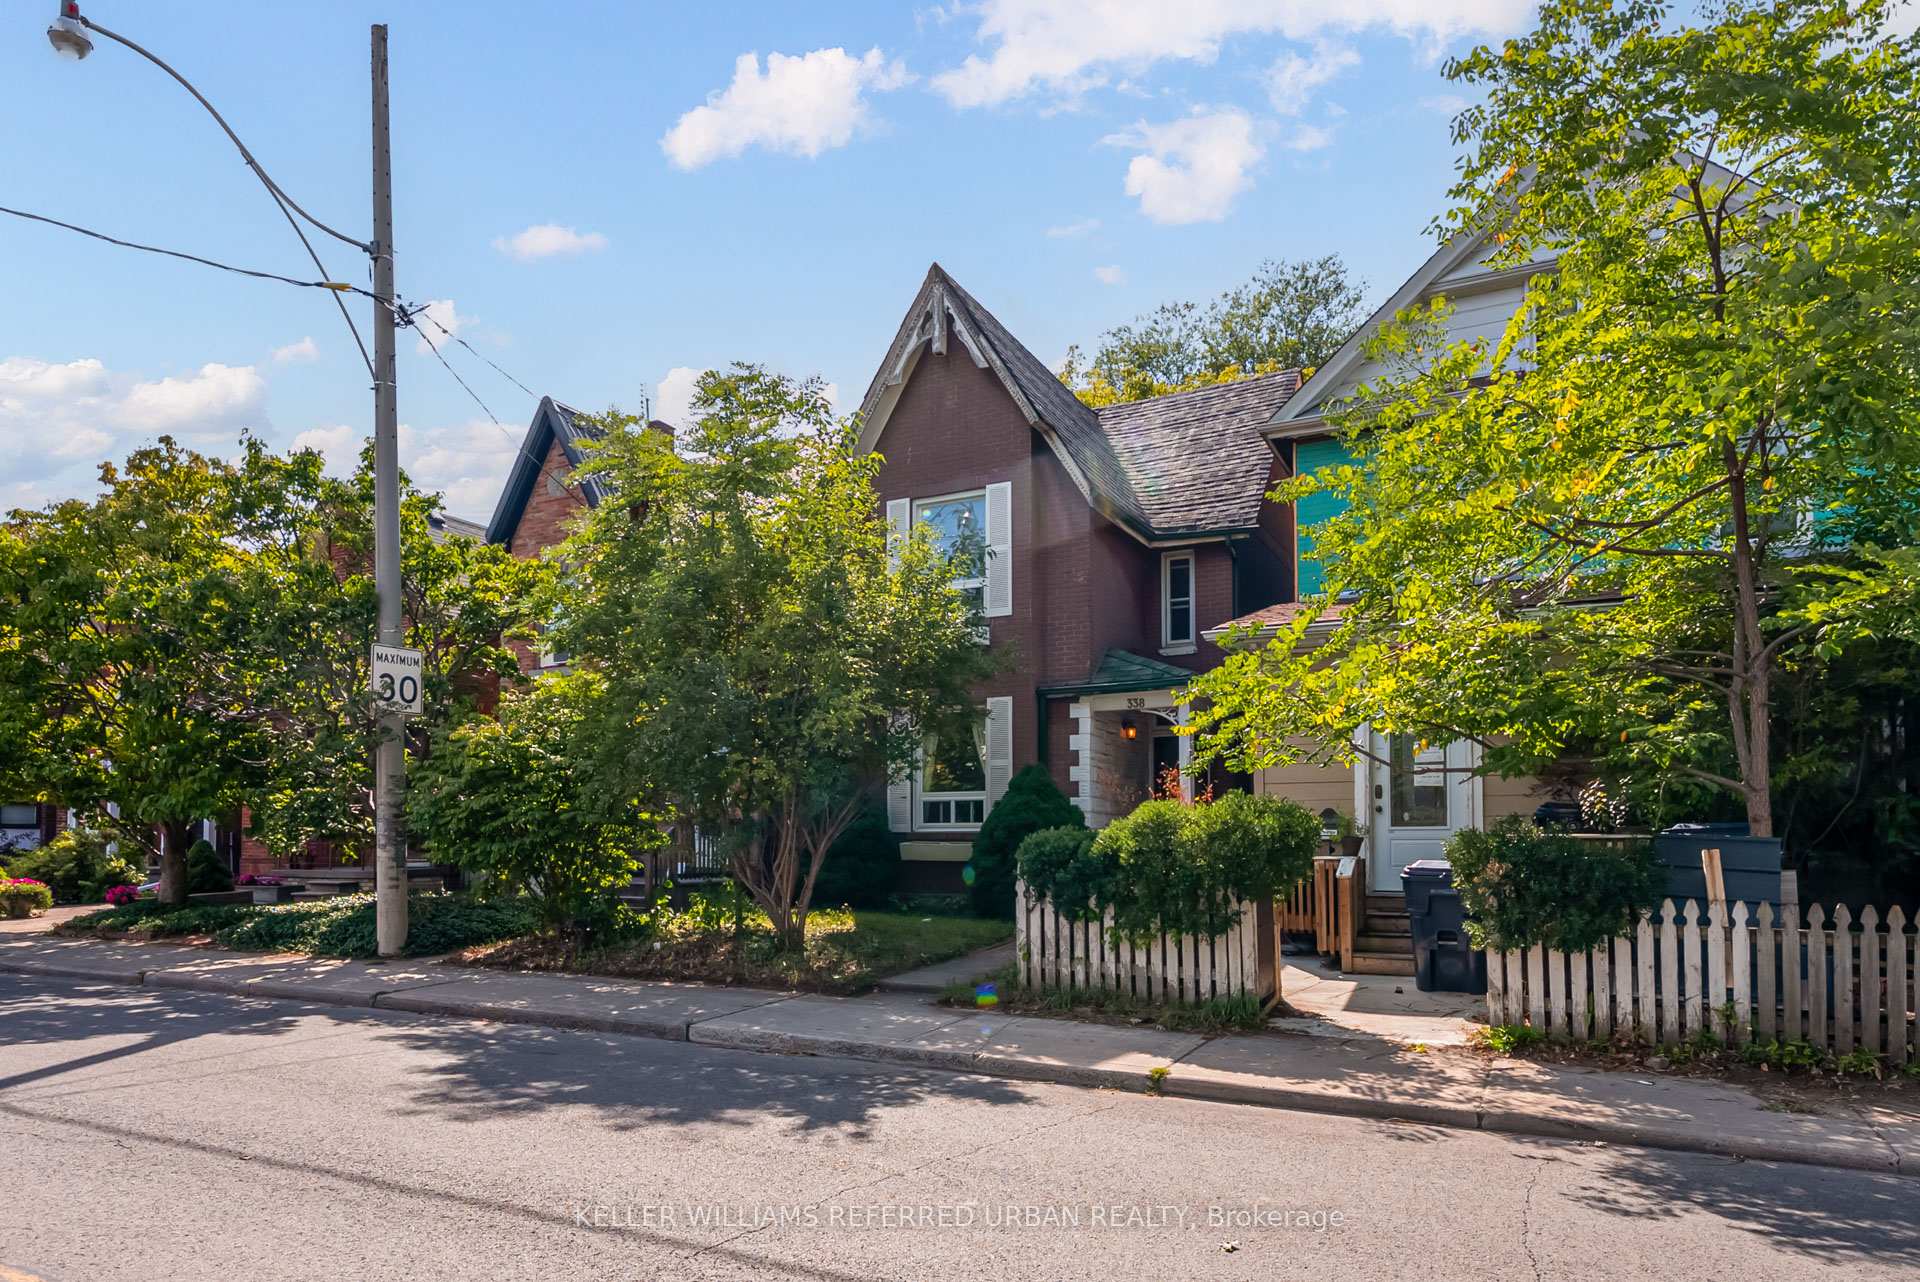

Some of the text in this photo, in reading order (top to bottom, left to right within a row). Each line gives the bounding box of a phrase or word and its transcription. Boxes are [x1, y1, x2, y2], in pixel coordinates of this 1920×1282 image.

[376, 652, 420, 667] MAXIMUM
[378, 672, 418, 704] 30
[1127, 697, 1145, 708] 338
